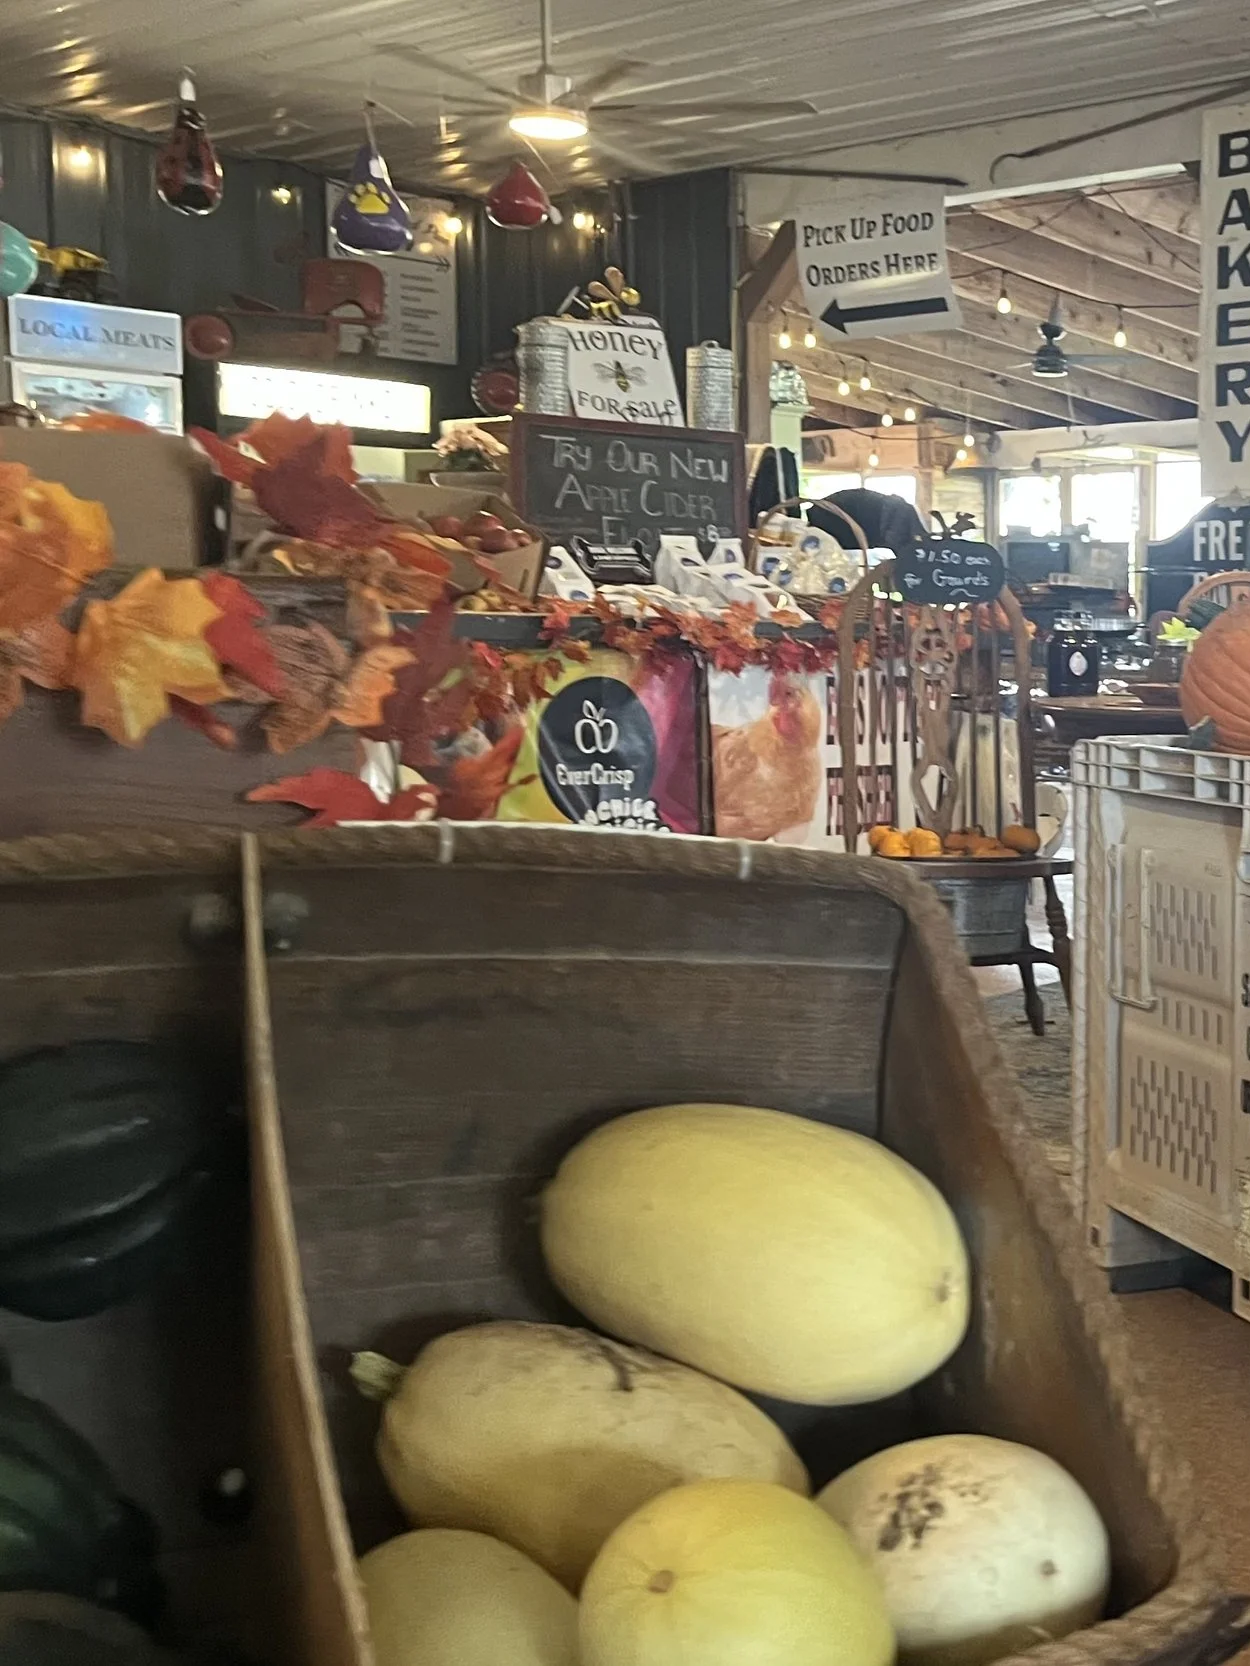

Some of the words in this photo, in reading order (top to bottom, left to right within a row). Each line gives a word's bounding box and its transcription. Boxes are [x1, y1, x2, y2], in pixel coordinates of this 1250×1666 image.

[803, 225, 847, 248] PICK
[881, 211, 934, 236] FOOD
[806, 260, 880, 287] ORDERS
[884, 252, 938, 276] HERE
[18, 316, 95, 342] LOCAL
[101, 327, 176, 350] MEATS
[669, 448, 728, 483] NEW
[554, 473, 632, 512] APPLE
[640, 480, 717, 521] CIDER
[555, 763, 635, 791] EverCrisp
